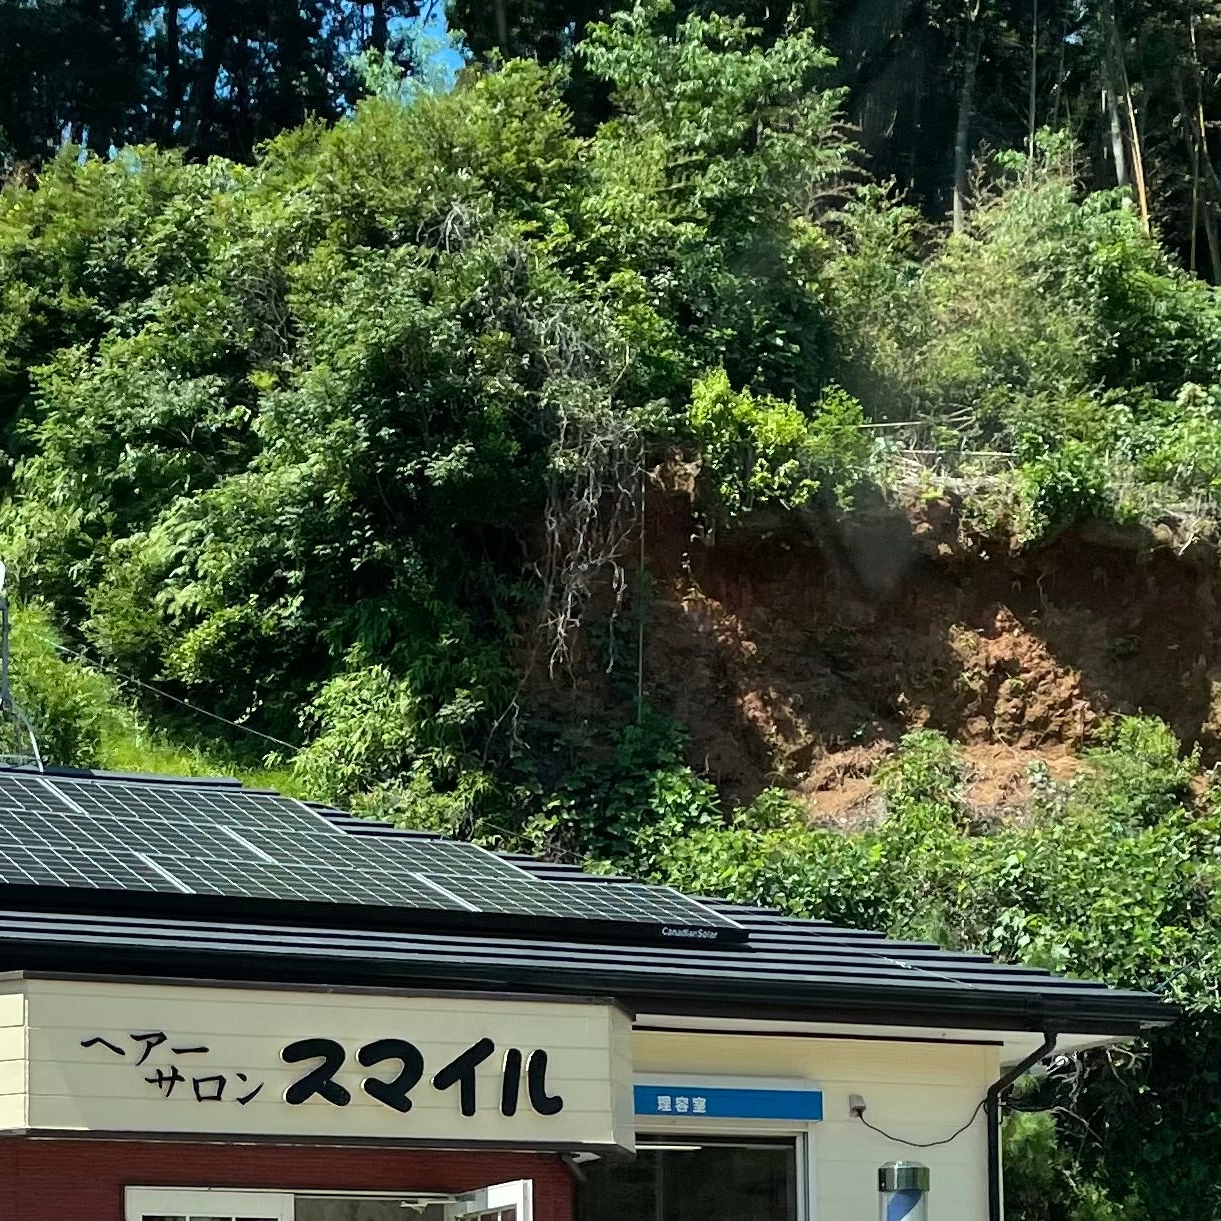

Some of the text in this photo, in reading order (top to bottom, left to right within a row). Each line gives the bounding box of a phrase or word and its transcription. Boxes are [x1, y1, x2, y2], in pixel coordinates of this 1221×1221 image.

[80, 1031, 211, 1067] ヘアー
[144, 1067, 265, 1105] サロン
[280, 1037, 564, 1119] スマイル
